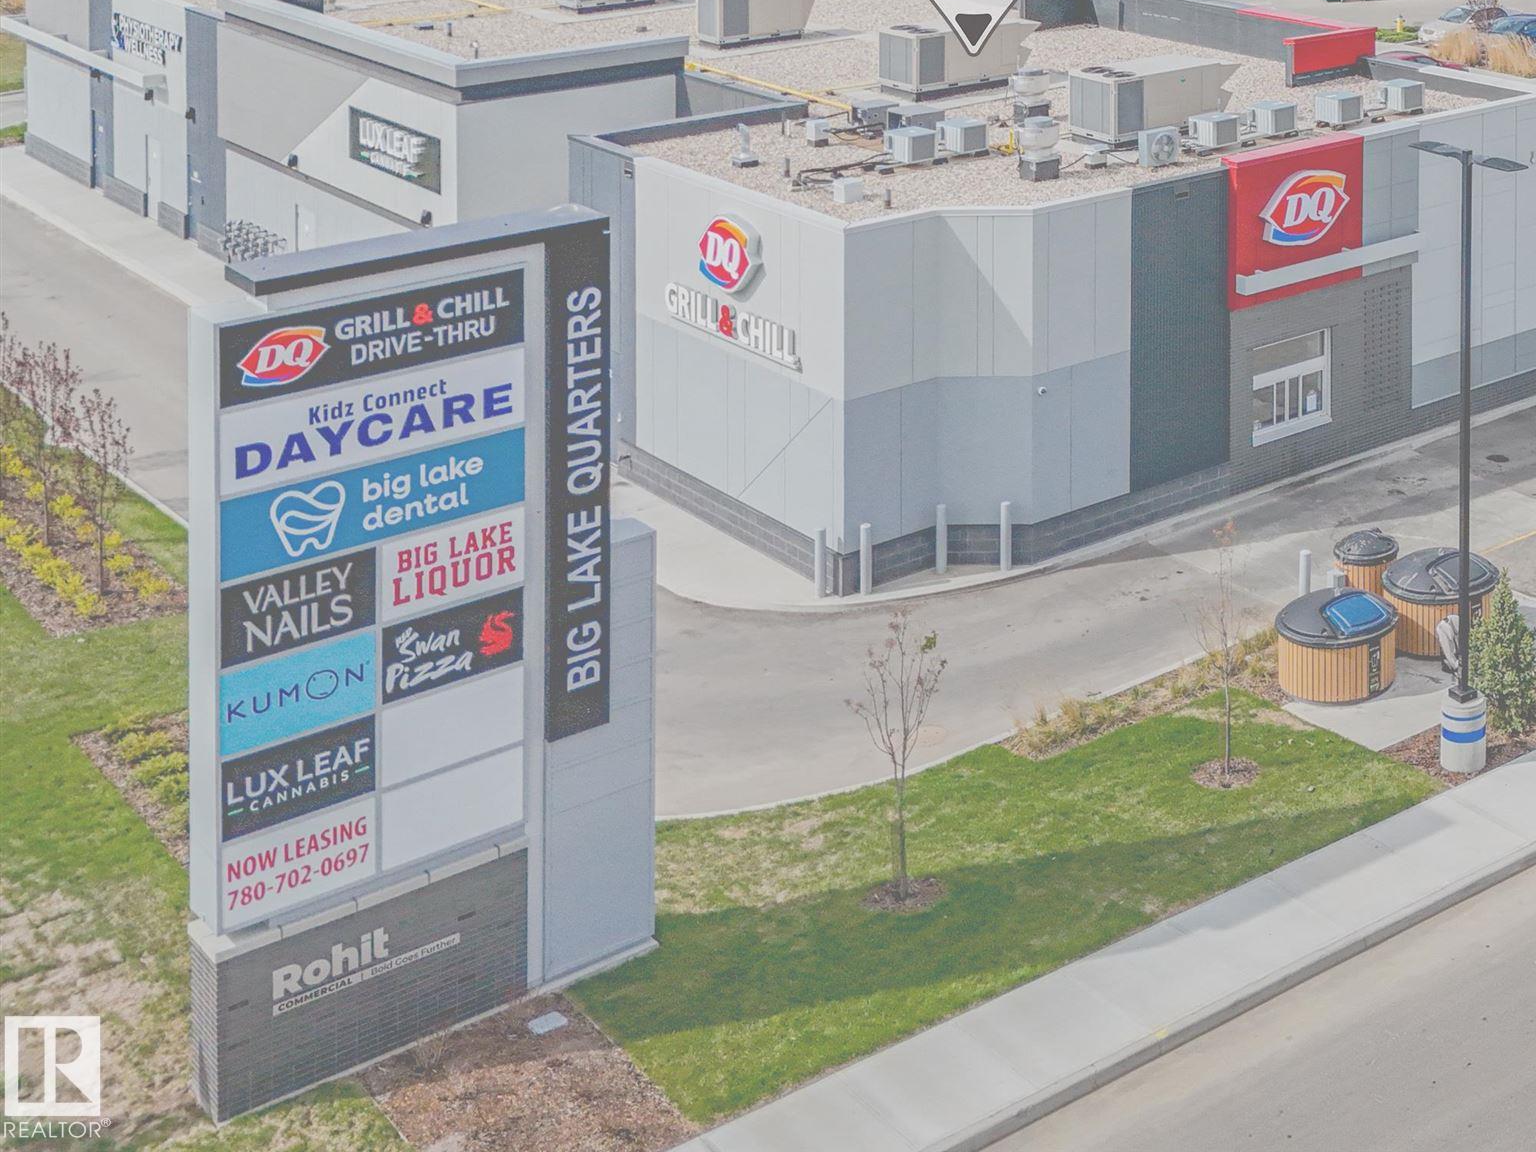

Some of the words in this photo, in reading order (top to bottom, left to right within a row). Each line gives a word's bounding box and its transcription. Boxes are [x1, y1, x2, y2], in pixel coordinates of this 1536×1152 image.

[1282, 186, 1336, 228] DQ
[705, 230, 741, 280] DQ
[334, 306, 412, 341] GRILL
[412, 302, 434, 326] &
[436, 286, 510, 320] CHILL
[664, 282, 719, 333] GRILL
[736, 311, 798, 366] CHILL
[254, 337, 315, 375] DQ
[349, 315, 497, 367] DRIVE-THRU
[308, 399, 355, 426] Kidz
[363, 378, 448, 414] Connect
[566, 285, 602, 496] QUARTERS
[234, 382, 513, 480] DAYCARE
[361, 471, 412, 504] big
[419, 455, 485, 488] lake
[361, 482, 470, 532] dental
[396, 540, 438, 574] BIG
[448, 520, 514, 559] LAKE
[566, 504, 602, 612] LAKE
[242, 561, 354, 615] VALLEY
[391, 544, 517, 607] LIQUOR
[242, 594, 354, 654] NAILS
[398, 628, 461, 664] Swan
[385, 649, 474, 695] Pizza
[566, 622, 601, 693] BIG
[226, 662, 366, 724] KUMON
[226, 763, 290, 807] LUX
[295, 737, 371, 784] LEAF
[249, 770, 350, 812] CANNABIS
[226, 846, 278, 884] NOW
[283, 815, 368, 864] LEASING
[226, 842, 370, 912] 780-702-0697
[272, 925, 390, 1000] Rohit
[277, 976, 354, 1012] COMMERCIAL
